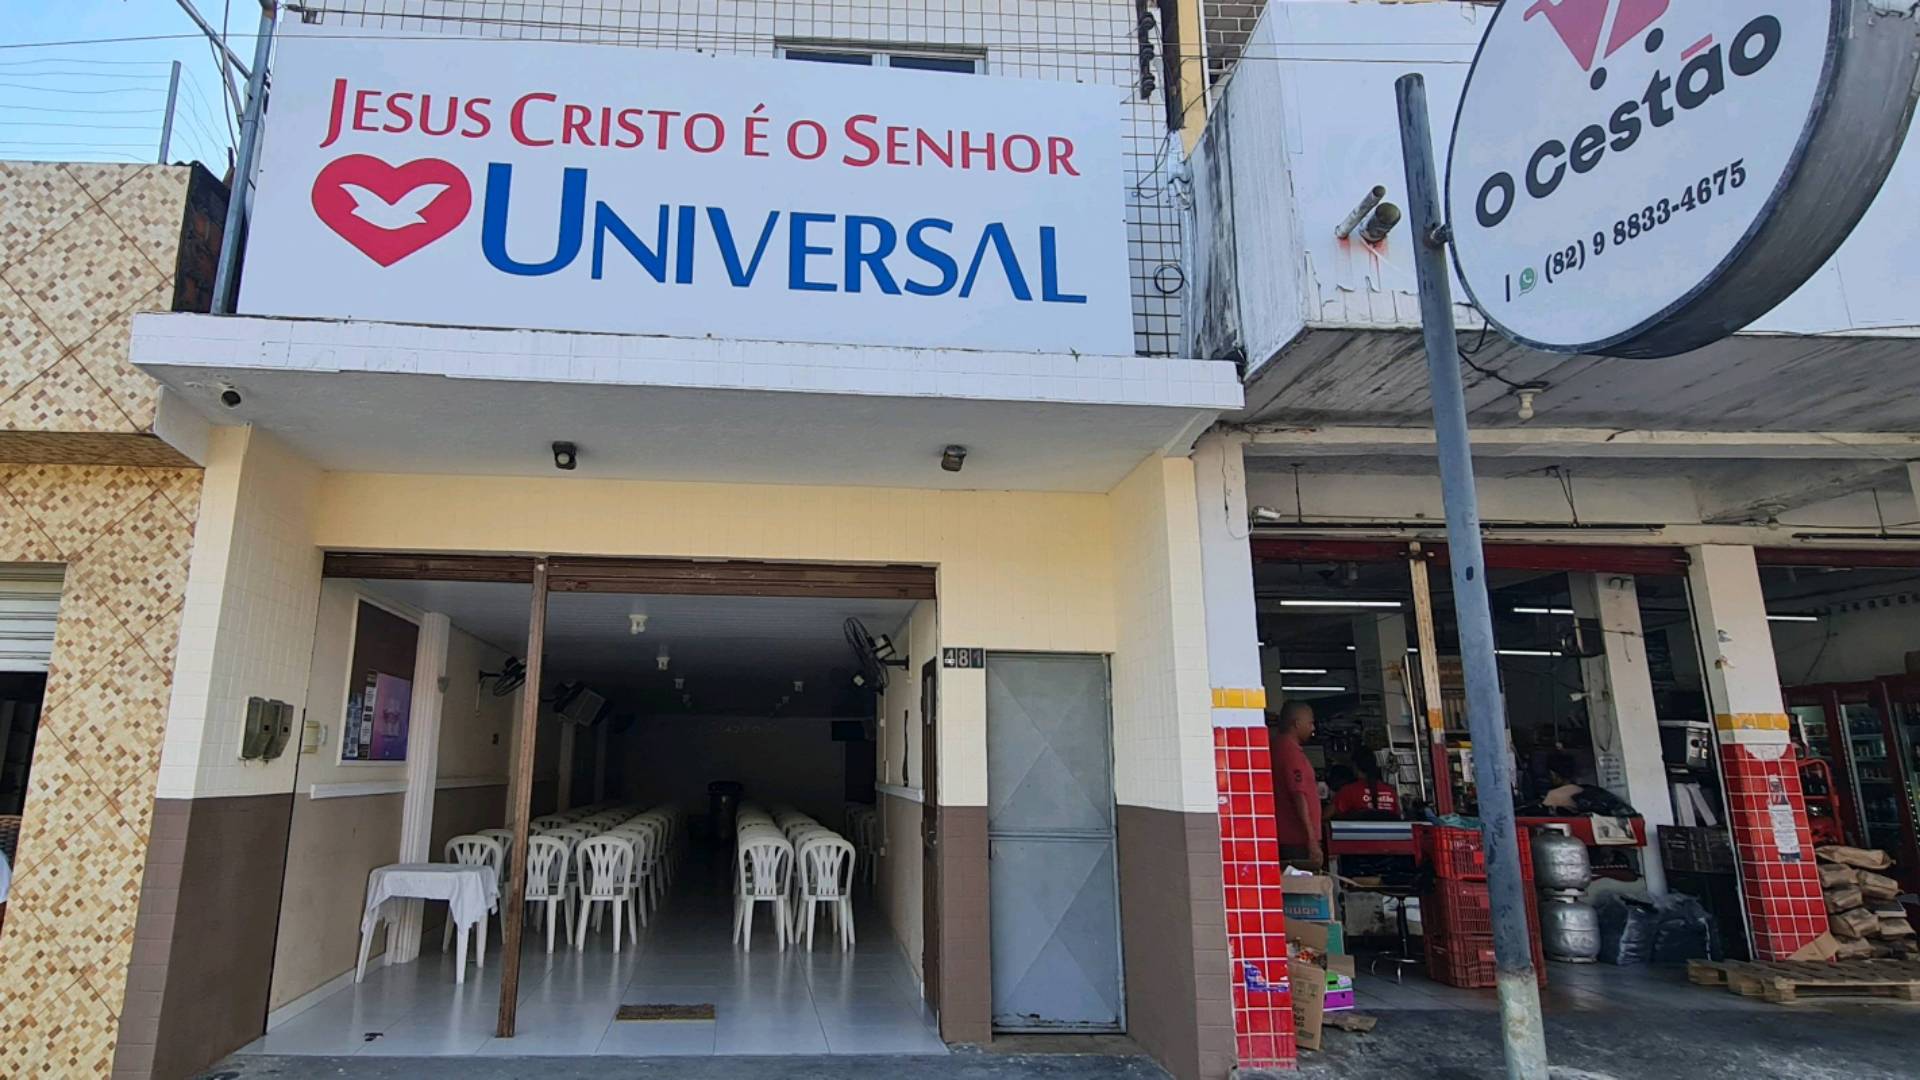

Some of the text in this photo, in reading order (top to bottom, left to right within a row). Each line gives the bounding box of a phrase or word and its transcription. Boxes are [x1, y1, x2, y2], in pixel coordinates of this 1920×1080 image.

[319, 79, 1080, 177] JESUS CRISTO É O SENHOR
[481, 162, 1088, 304] UNIVERSAL
[1545, 157, 1748, 284] (82) 9 8833-4675
